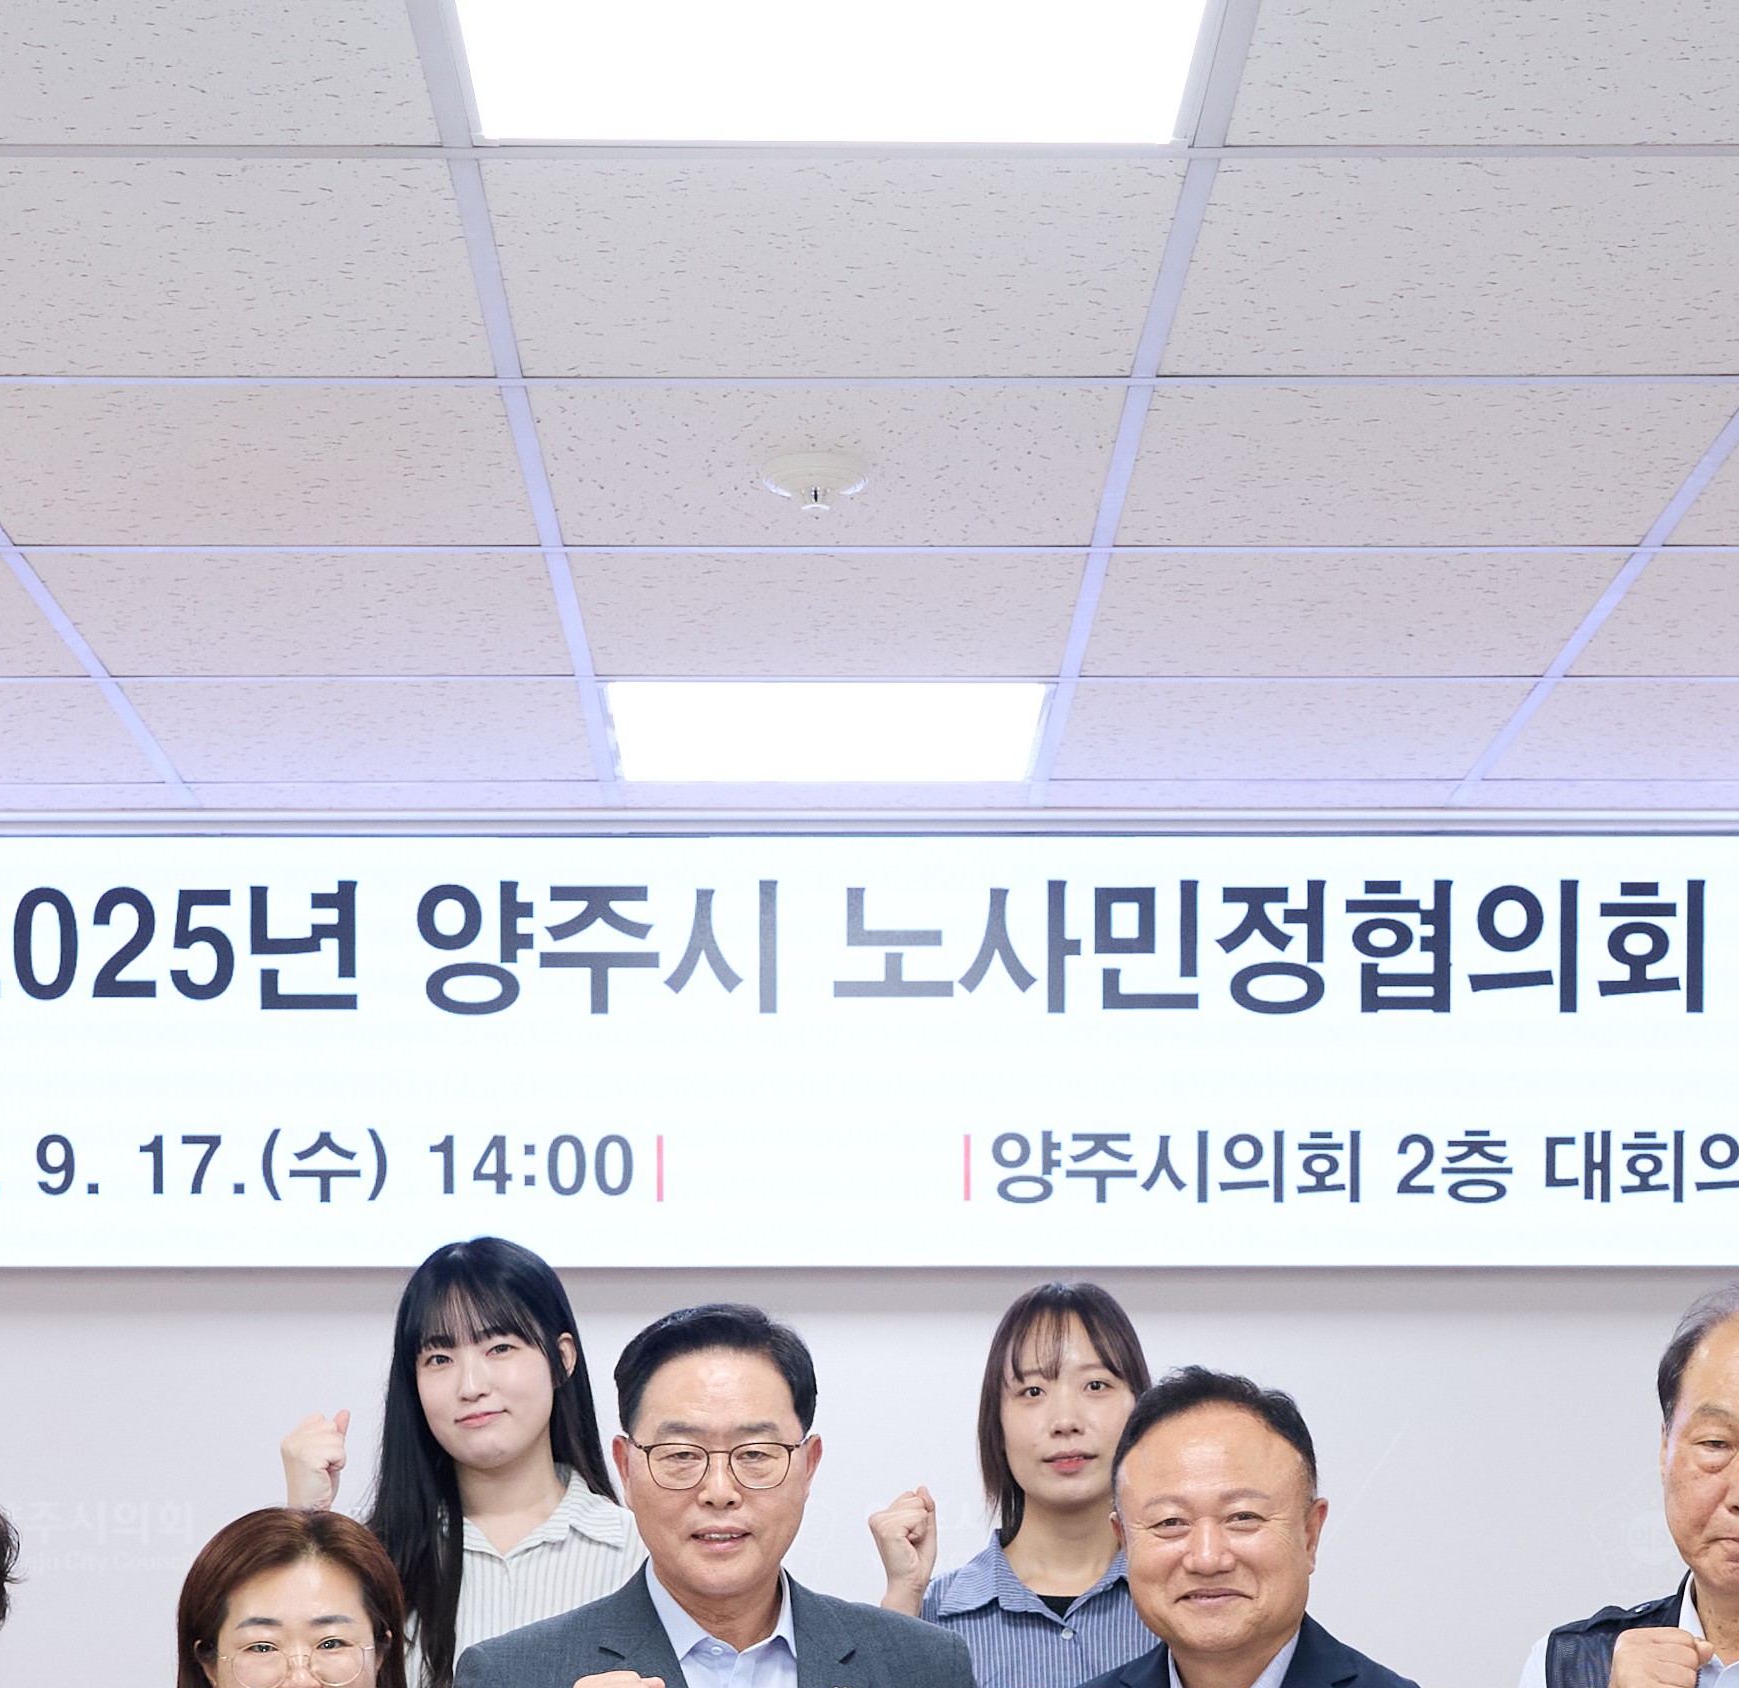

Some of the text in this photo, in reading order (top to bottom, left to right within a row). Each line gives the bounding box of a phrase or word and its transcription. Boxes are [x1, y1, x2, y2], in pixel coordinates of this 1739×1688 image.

[415, 879, 779, 1016] 양주시
[832, 878, 1708, 1016] 노사민정협의회
[34, 1133, 101, 1197] 9.
[137, 1127, 389, 1204] 17.(수)
[428, 1133, 635, 1197] 14:00
[990, 1129, 1363, 1204] 양주시의회
[1396, 1129, 1515, 1204] 2층
[11, 1501, 193, 1545] 주시의회
